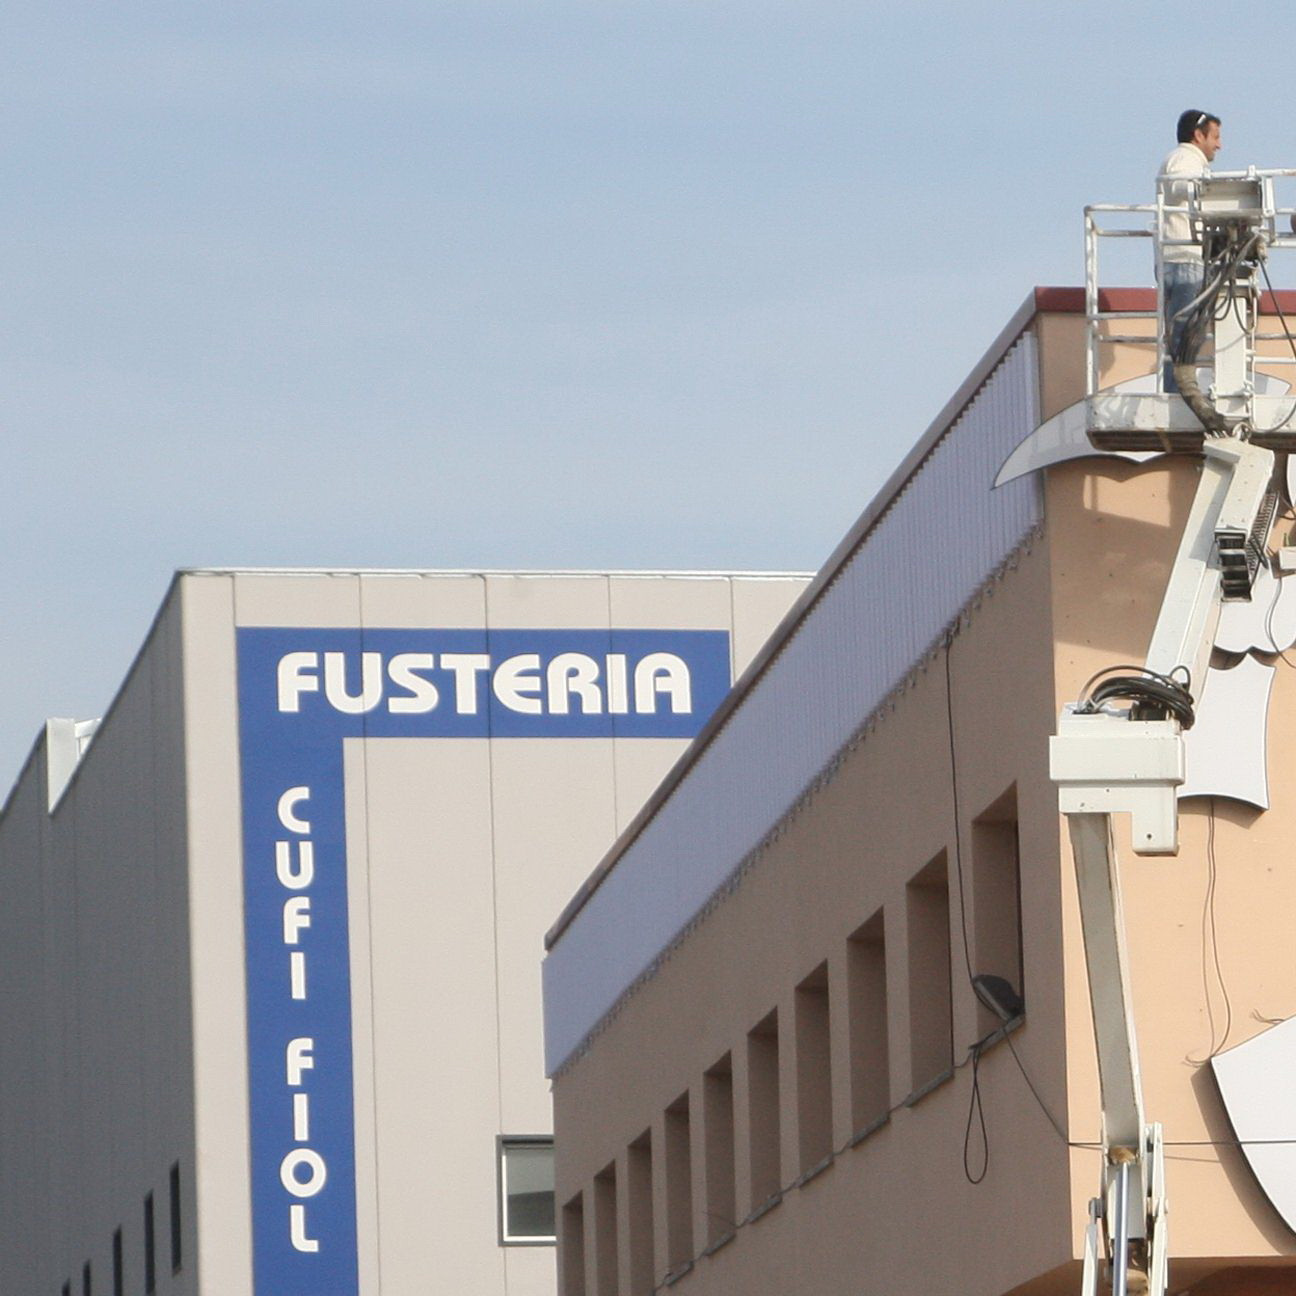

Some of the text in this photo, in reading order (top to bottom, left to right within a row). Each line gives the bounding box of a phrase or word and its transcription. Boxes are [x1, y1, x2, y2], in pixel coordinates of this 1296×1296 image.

[276, 650, 694, 716] FUSTERIA
[275, 785, 328, 1254] CUFI FIOL
